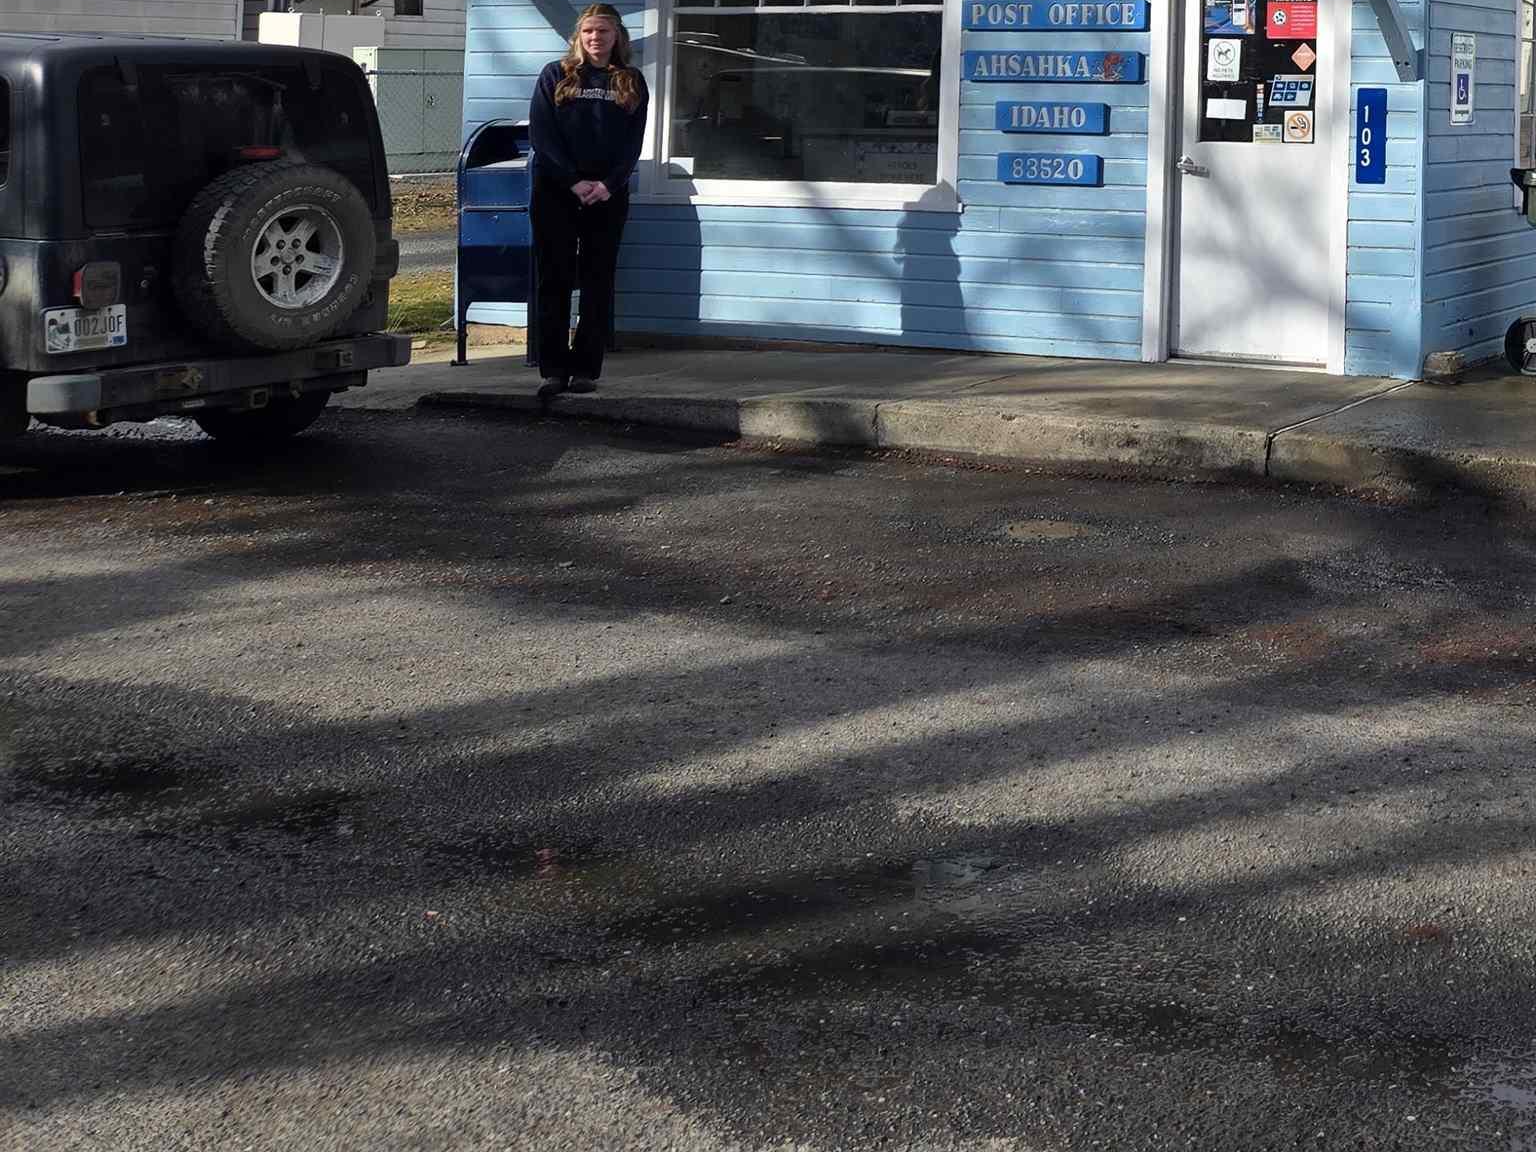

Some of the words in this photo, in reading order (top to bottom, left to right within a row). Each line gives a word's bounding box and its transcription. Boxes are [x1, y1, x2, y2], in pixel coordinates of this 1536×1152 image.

[971, 3, 1033, 25] POST
[1048, 2, 1136, 26] OFFICE
[973, 54, 1091, 78] AHSAHKA
[1010, 105, 1087, 129] IDAHO
[1360, 105, 1372, 167] 103
[1012, 157, 1084, 181] 83520
